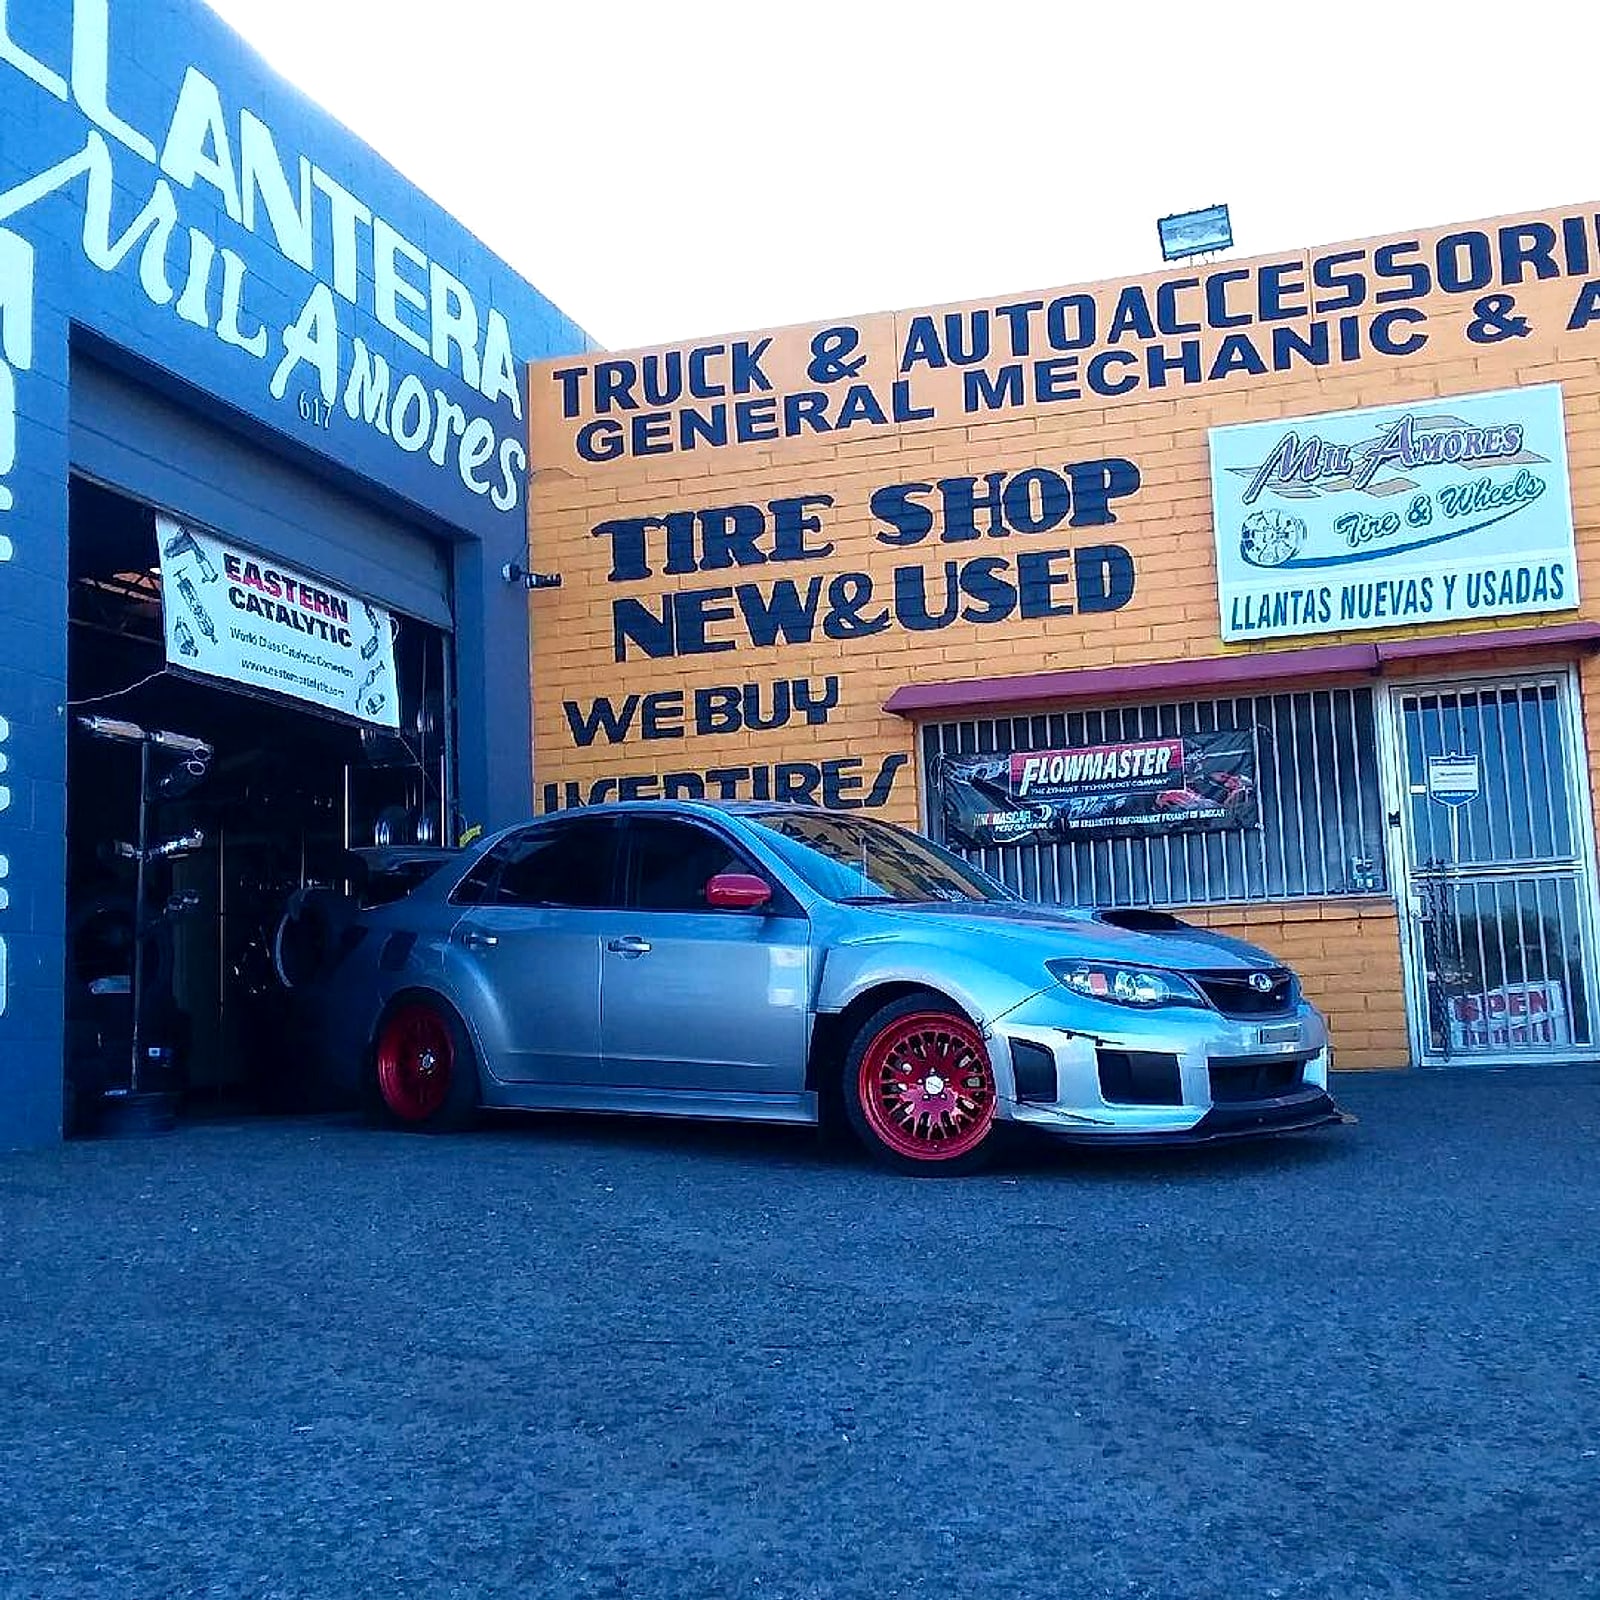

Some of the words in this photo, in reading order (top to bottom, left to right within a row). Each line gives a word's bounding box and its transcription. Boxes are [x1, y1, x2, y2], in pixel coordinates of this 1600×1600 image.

[553, 338, 774, 417] TRUCK
[807, 326, 867, 384] &
[900, 294, 1096, 372] AUTO
[1108, 213, 1600, 344] ACCESSORI
[299, 392, 332, 428] 617
[576, 380, 934, 462] GENERAL
[964, 307, 1428, 413] MECHANIC
[1466, 294, 1533, 343] &
[592, 494, 834, 582] TIRE
[870, 457, 1141, 545] SHOP
[1334, 510, 1400, 547] Tire
[1405, 494, 1432, 527] &
[1437, 469, 1546, 518] Wheels
[223, 552, 348, 623] EASTERN
[228, 586, 353, 648] CATALYTIC
[1231, 586, 1331, 631] LLANTAS
[1341, 577, 1433, 622] NUEVAS
[1443, 574, 1458, 610] Y
[1467, 563, 1564, 609] USADAS
[563, 691, 684, 747] WE
[695, 676, 839, 736] BUY
[1019, 746, 1172, 797] FLOWMASTER
